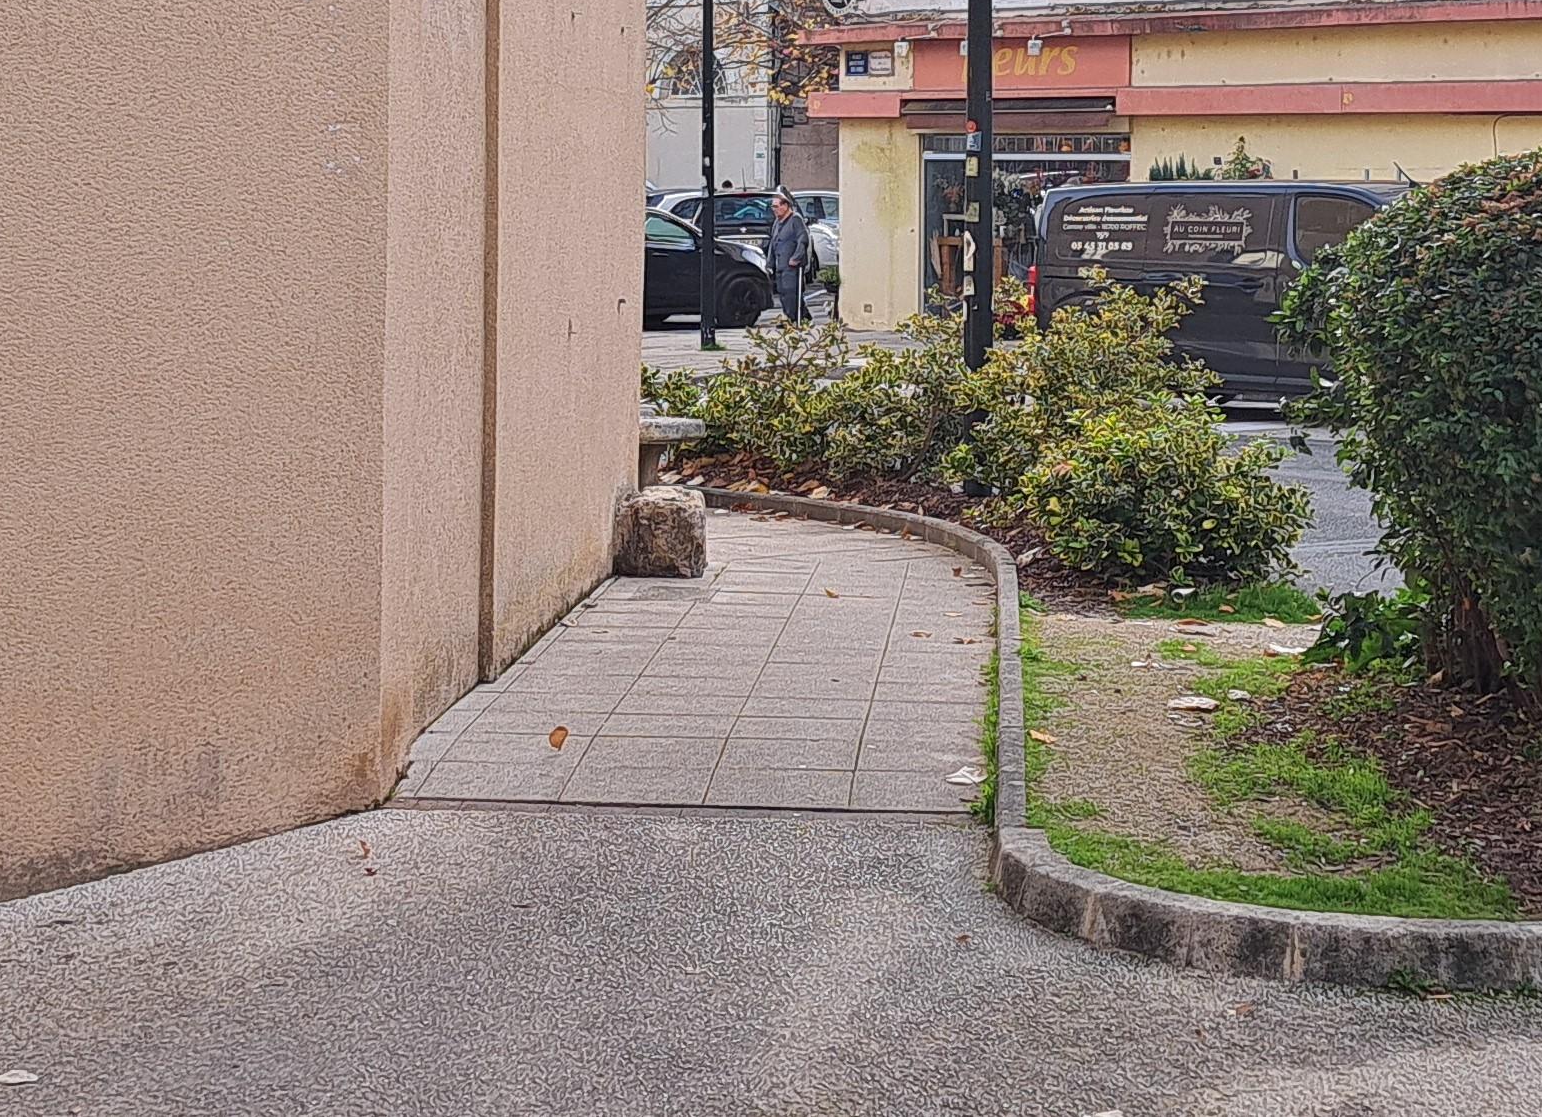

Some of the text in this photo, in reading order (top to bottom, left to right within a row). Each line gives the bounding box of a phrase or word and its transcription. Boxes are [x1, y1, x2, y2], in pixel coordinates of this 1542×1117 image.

[1173, 225, 1240, 234] AU COIN FLEURI
